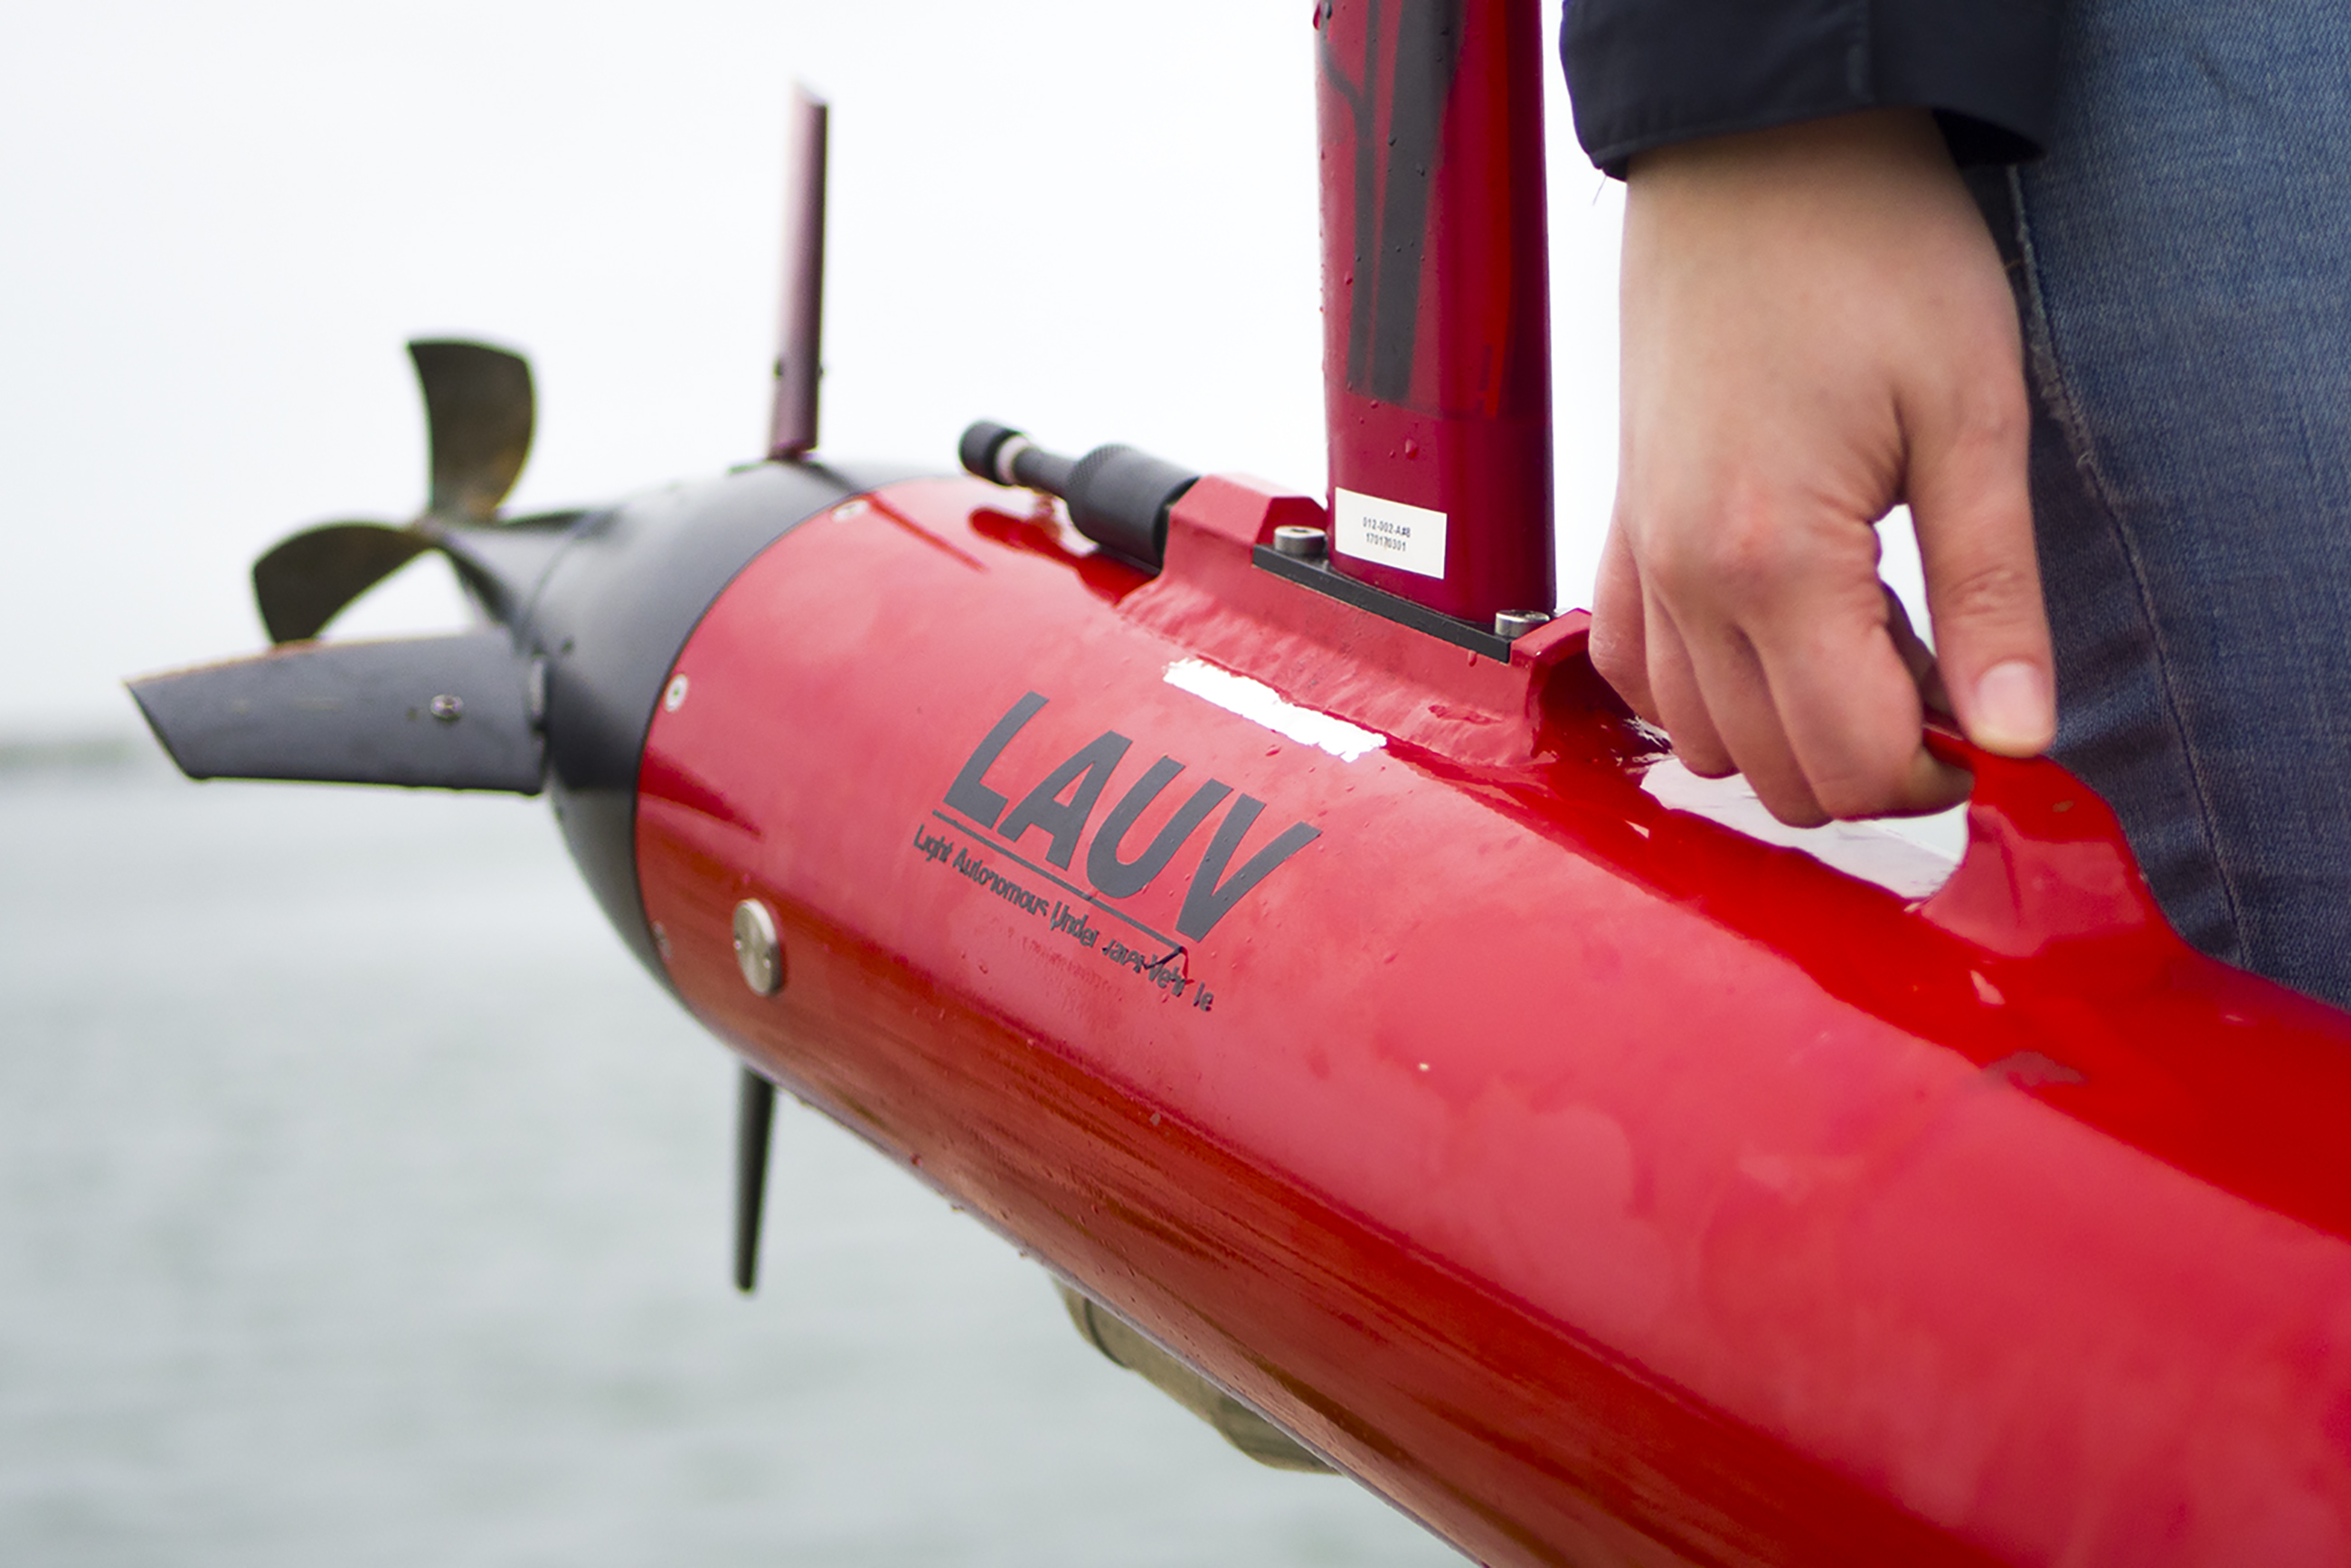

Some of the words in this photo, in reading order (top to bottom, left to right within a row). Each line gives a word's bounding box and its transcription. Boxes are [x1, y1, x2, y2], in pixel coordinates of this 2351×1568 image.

[913, 824, 954, 863] Light
[952, 847, 1050, 916] Autonomous
[1148, 954, 1214, 1012] Vehile
[943, 691, 1323, 943] LAUV
